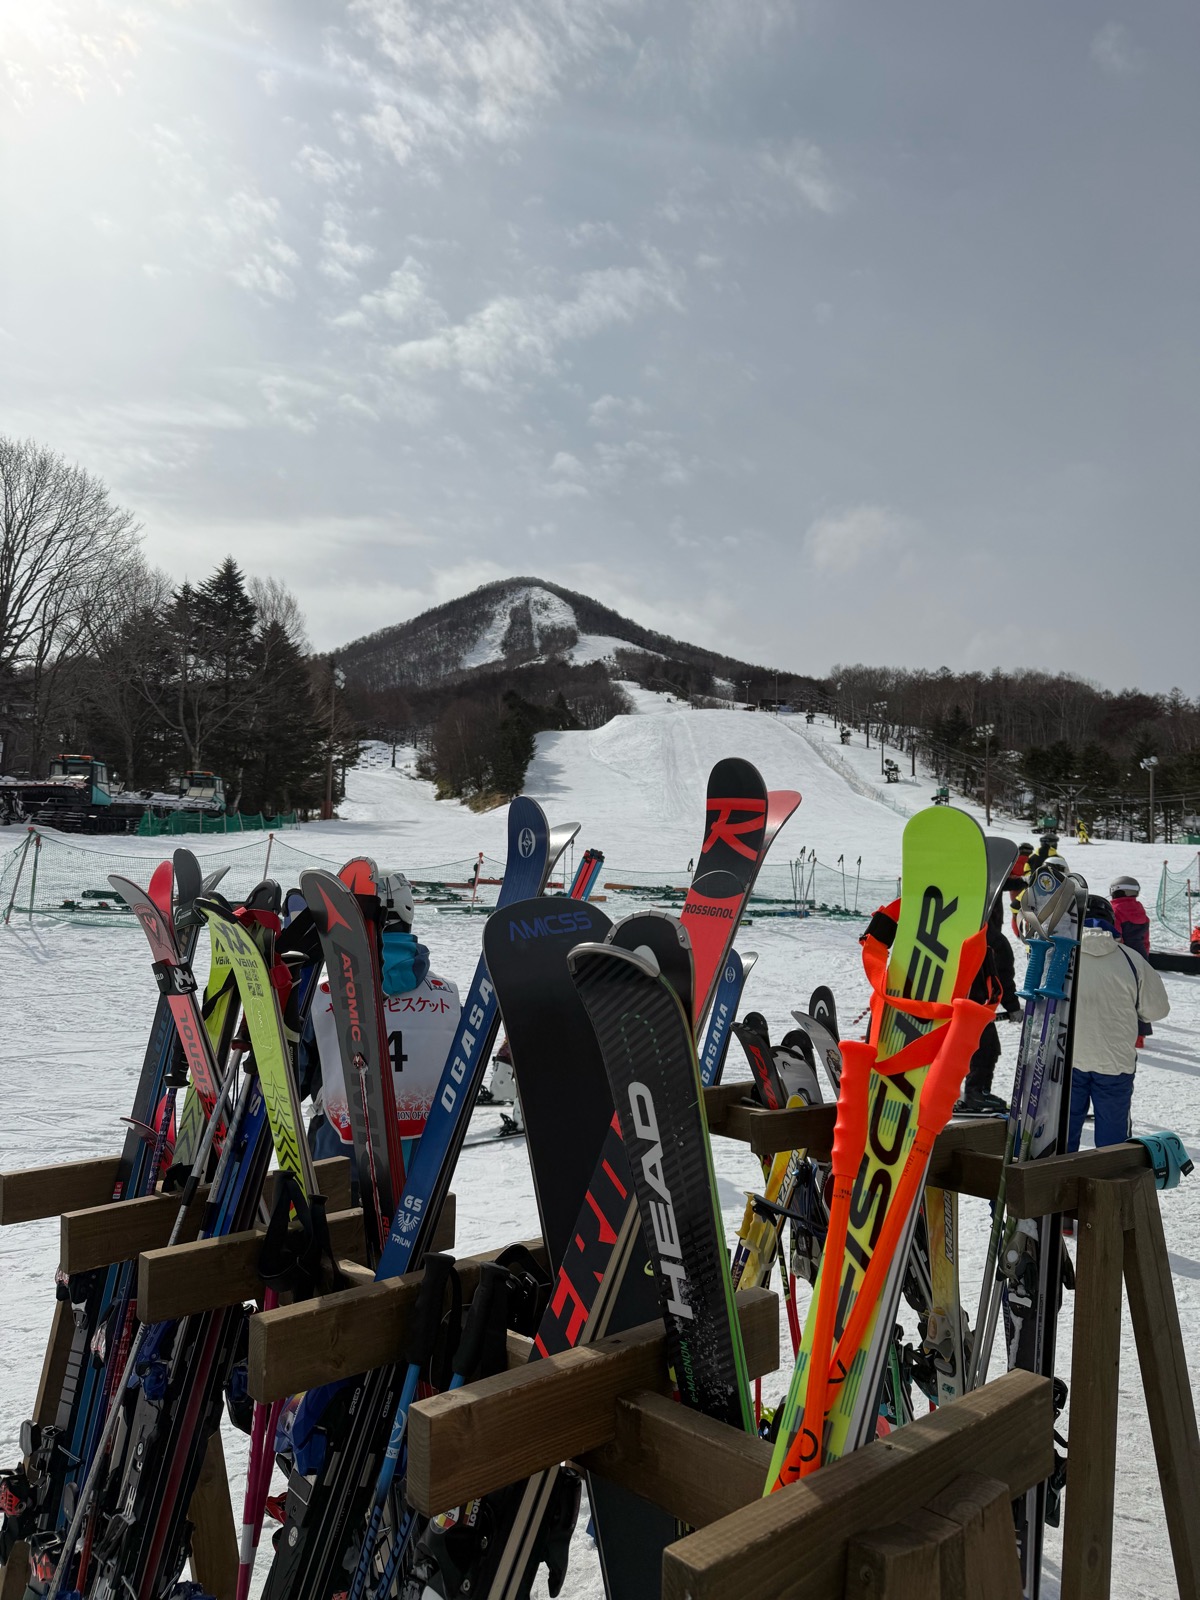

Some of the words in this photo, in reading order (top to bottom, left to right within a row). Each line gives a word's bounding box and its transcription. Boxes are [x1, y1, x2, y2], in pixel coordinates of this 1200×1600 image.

[684, 903, 734, 919] ROSSIGNOL
[509, 911, 593, 942] AMICSS
[235, 957, 259, 969] Völkl
[341, 952, 362, 1043] ATOMIC
[700, 1003, 729, 1088] GASAKA
[411, 1111, 421, 1120] OF
[404, 1194, 424, 1213] GS
[627, 1080, 695, 1321] HEAD
[391, 1233, 412, 1249] TRIUN
[944, 1190, 955, 1264] KAZAMA
[468, 1497, 482, 1527] LOOK
